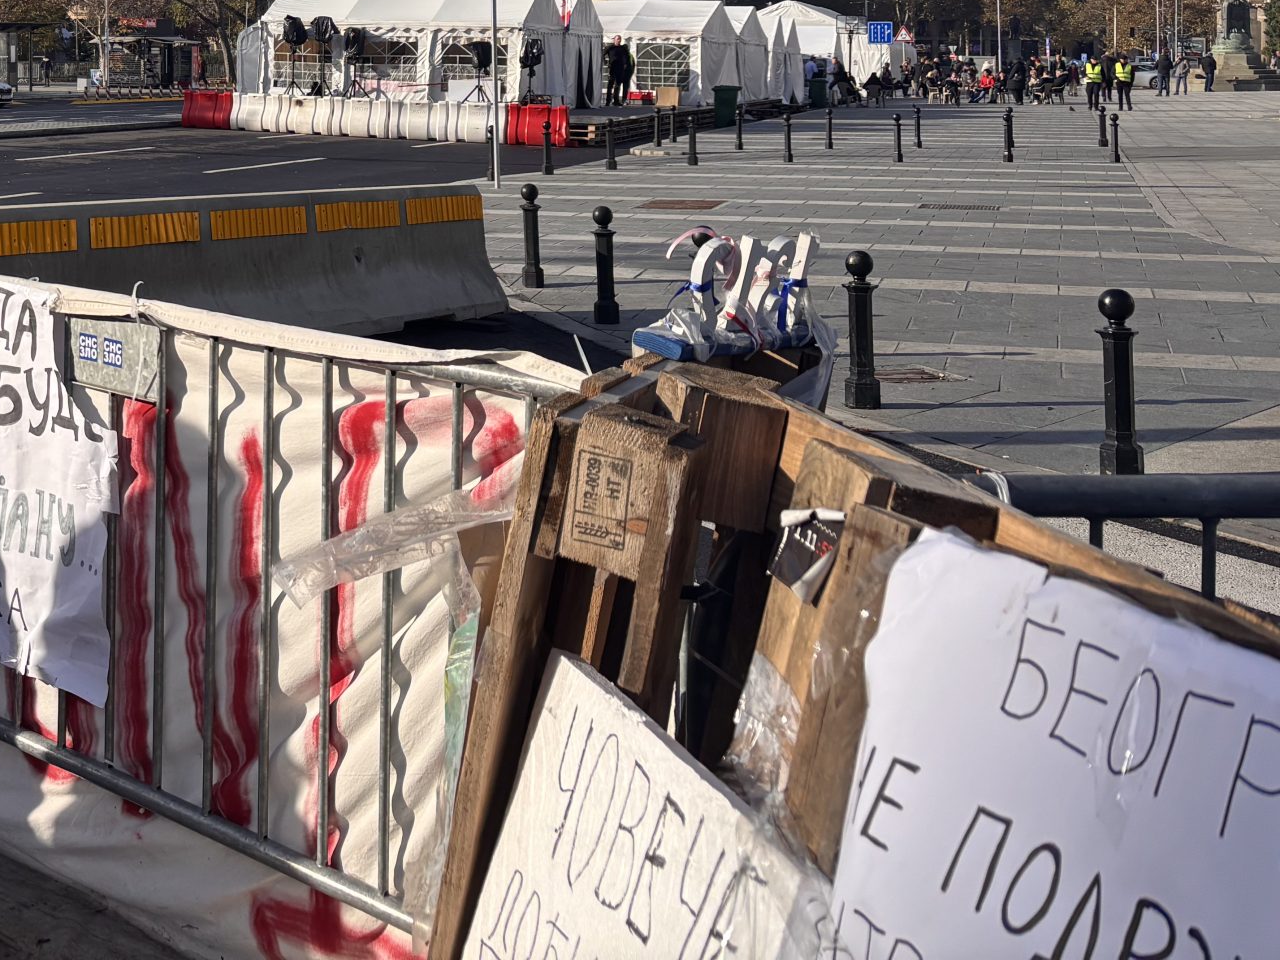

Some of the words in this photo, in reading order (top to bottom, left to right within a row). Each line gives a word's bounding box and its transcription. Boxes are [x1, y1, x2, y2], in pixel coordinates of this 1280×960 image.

[79, 335, 98, 349] СНС
[103, 340, 123, 354] СНС
[79, 346, 98, 360] ЗЛО
[103, 351, 123, 366] ЗЛО
